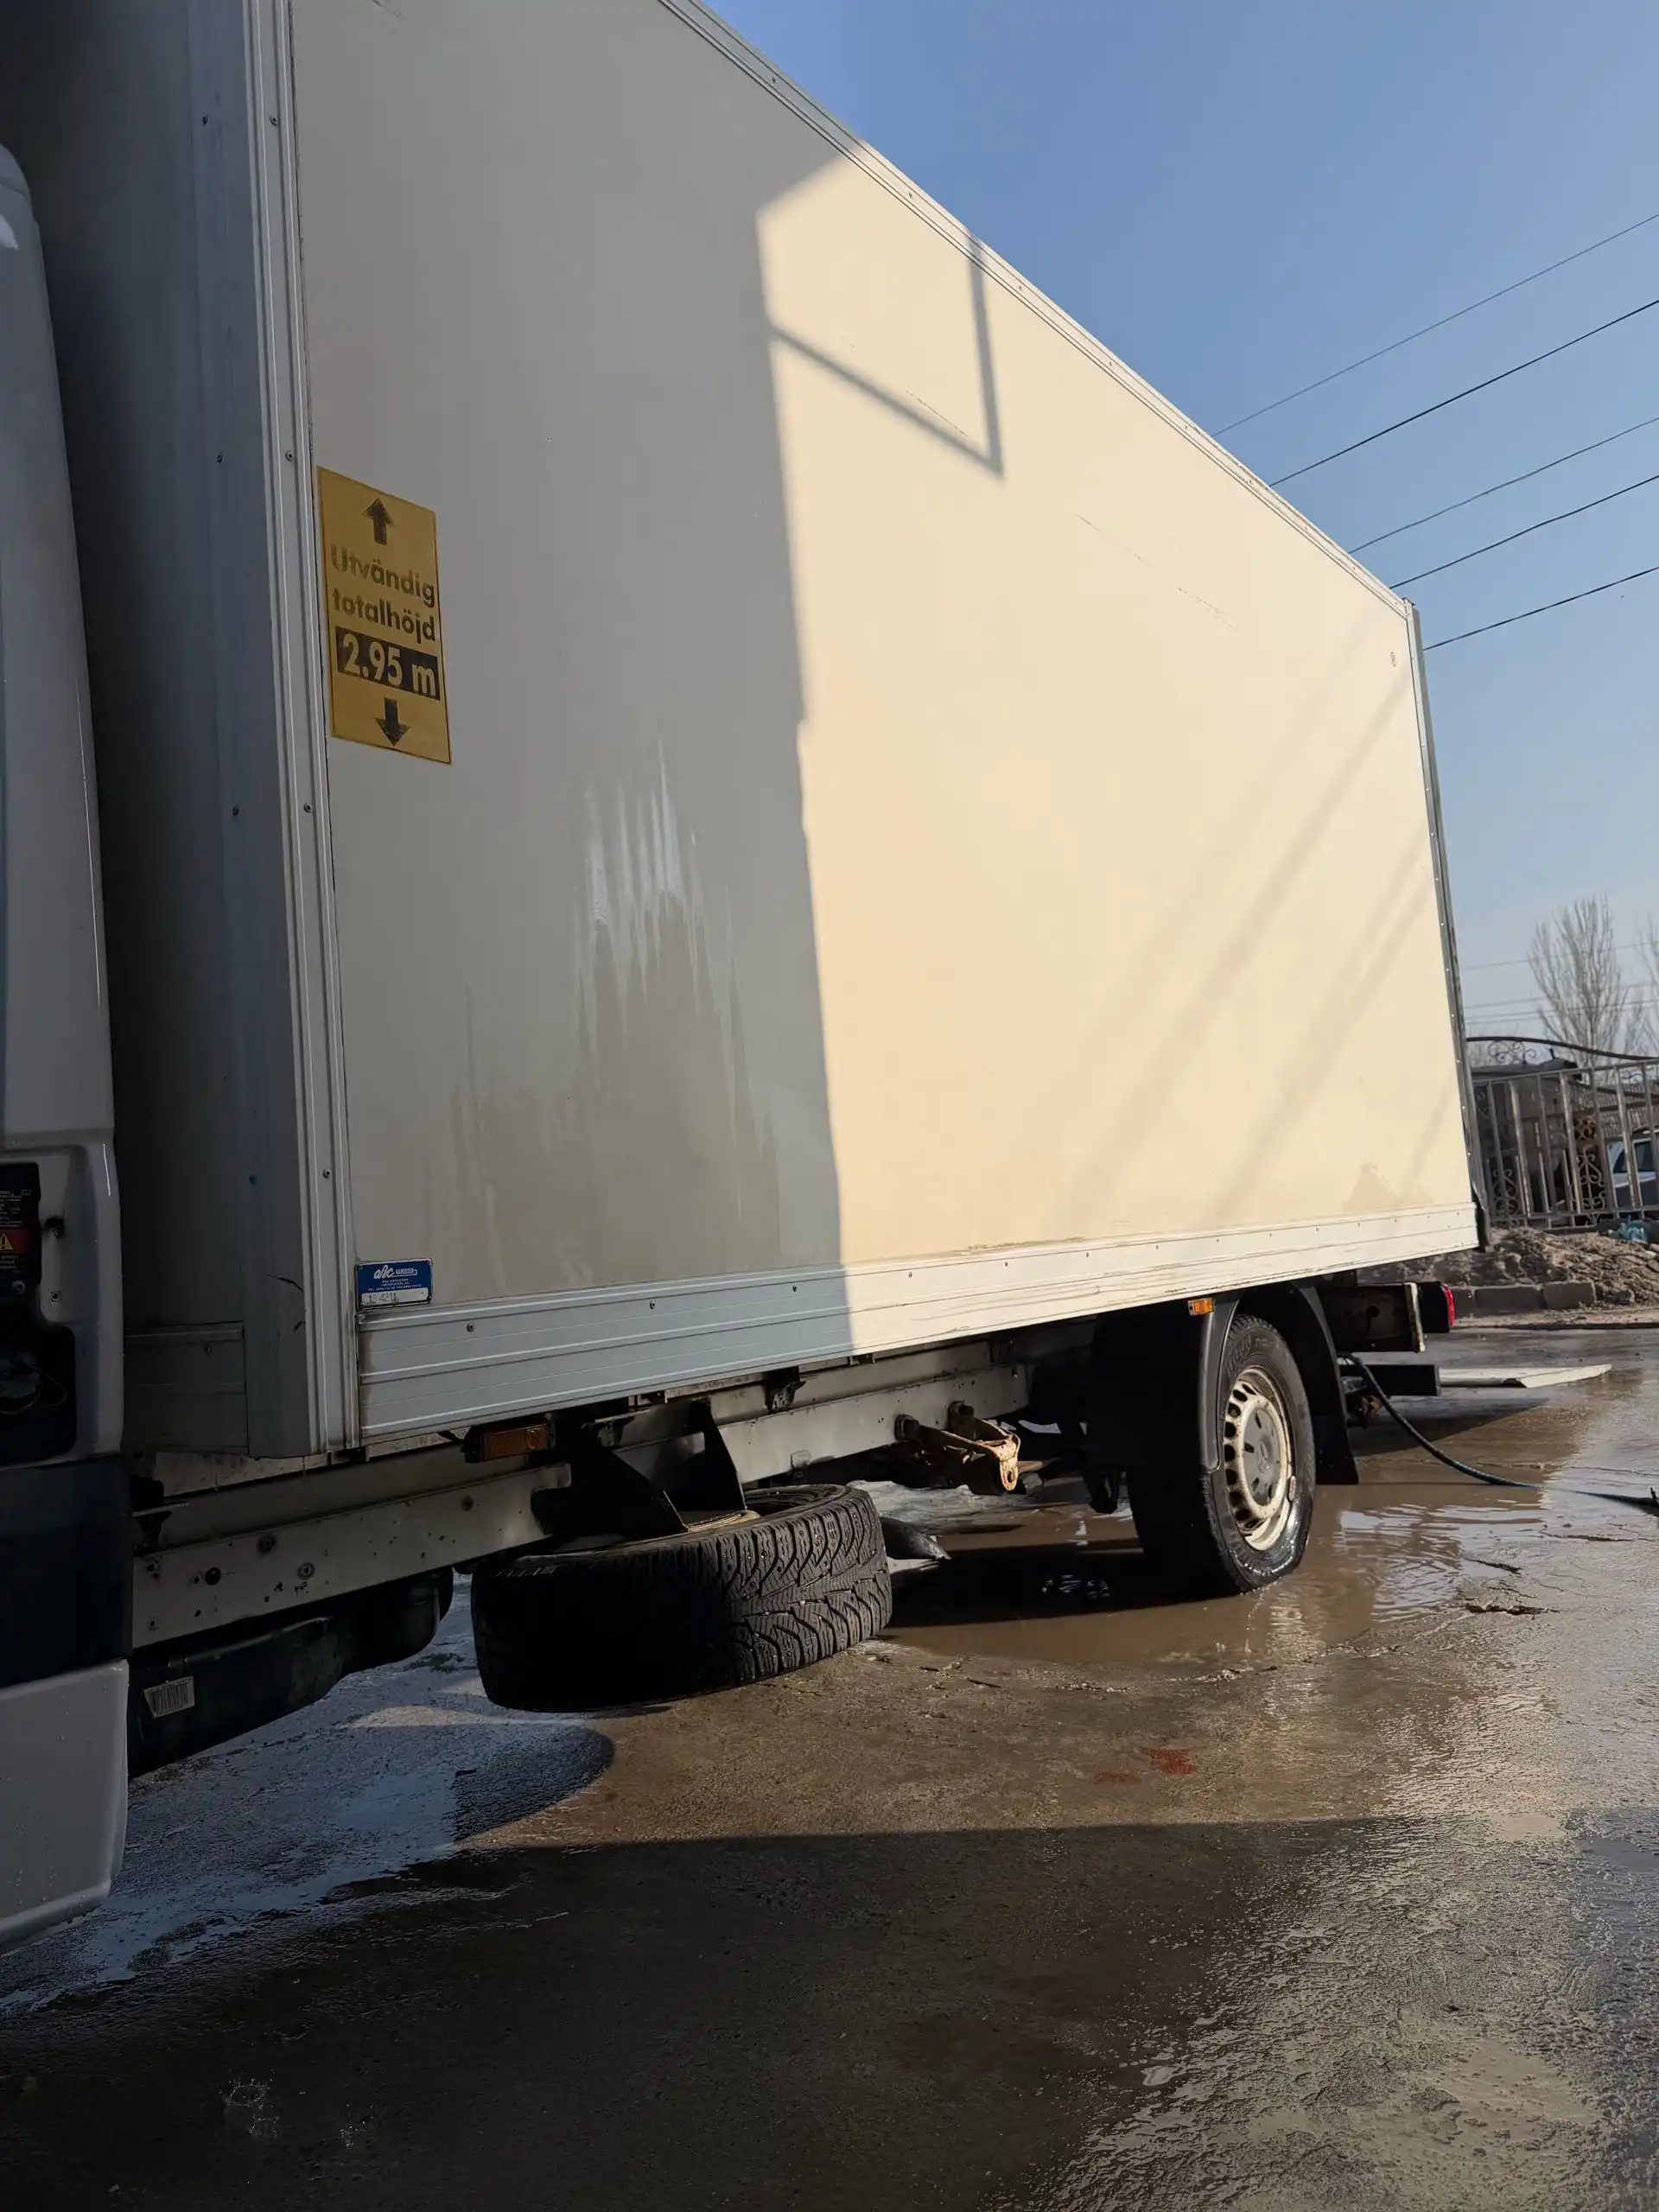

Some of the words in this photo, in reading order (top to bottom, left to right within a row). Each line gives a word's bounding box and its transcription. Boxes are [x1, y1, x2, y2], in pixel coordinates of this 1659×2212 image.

[331, 543, 435, 607] Utvändig
[332, 588, 435, 644] totalhöjd
[343, 633, 403, 686] 2.95
[411, 664, 436, 697] m
